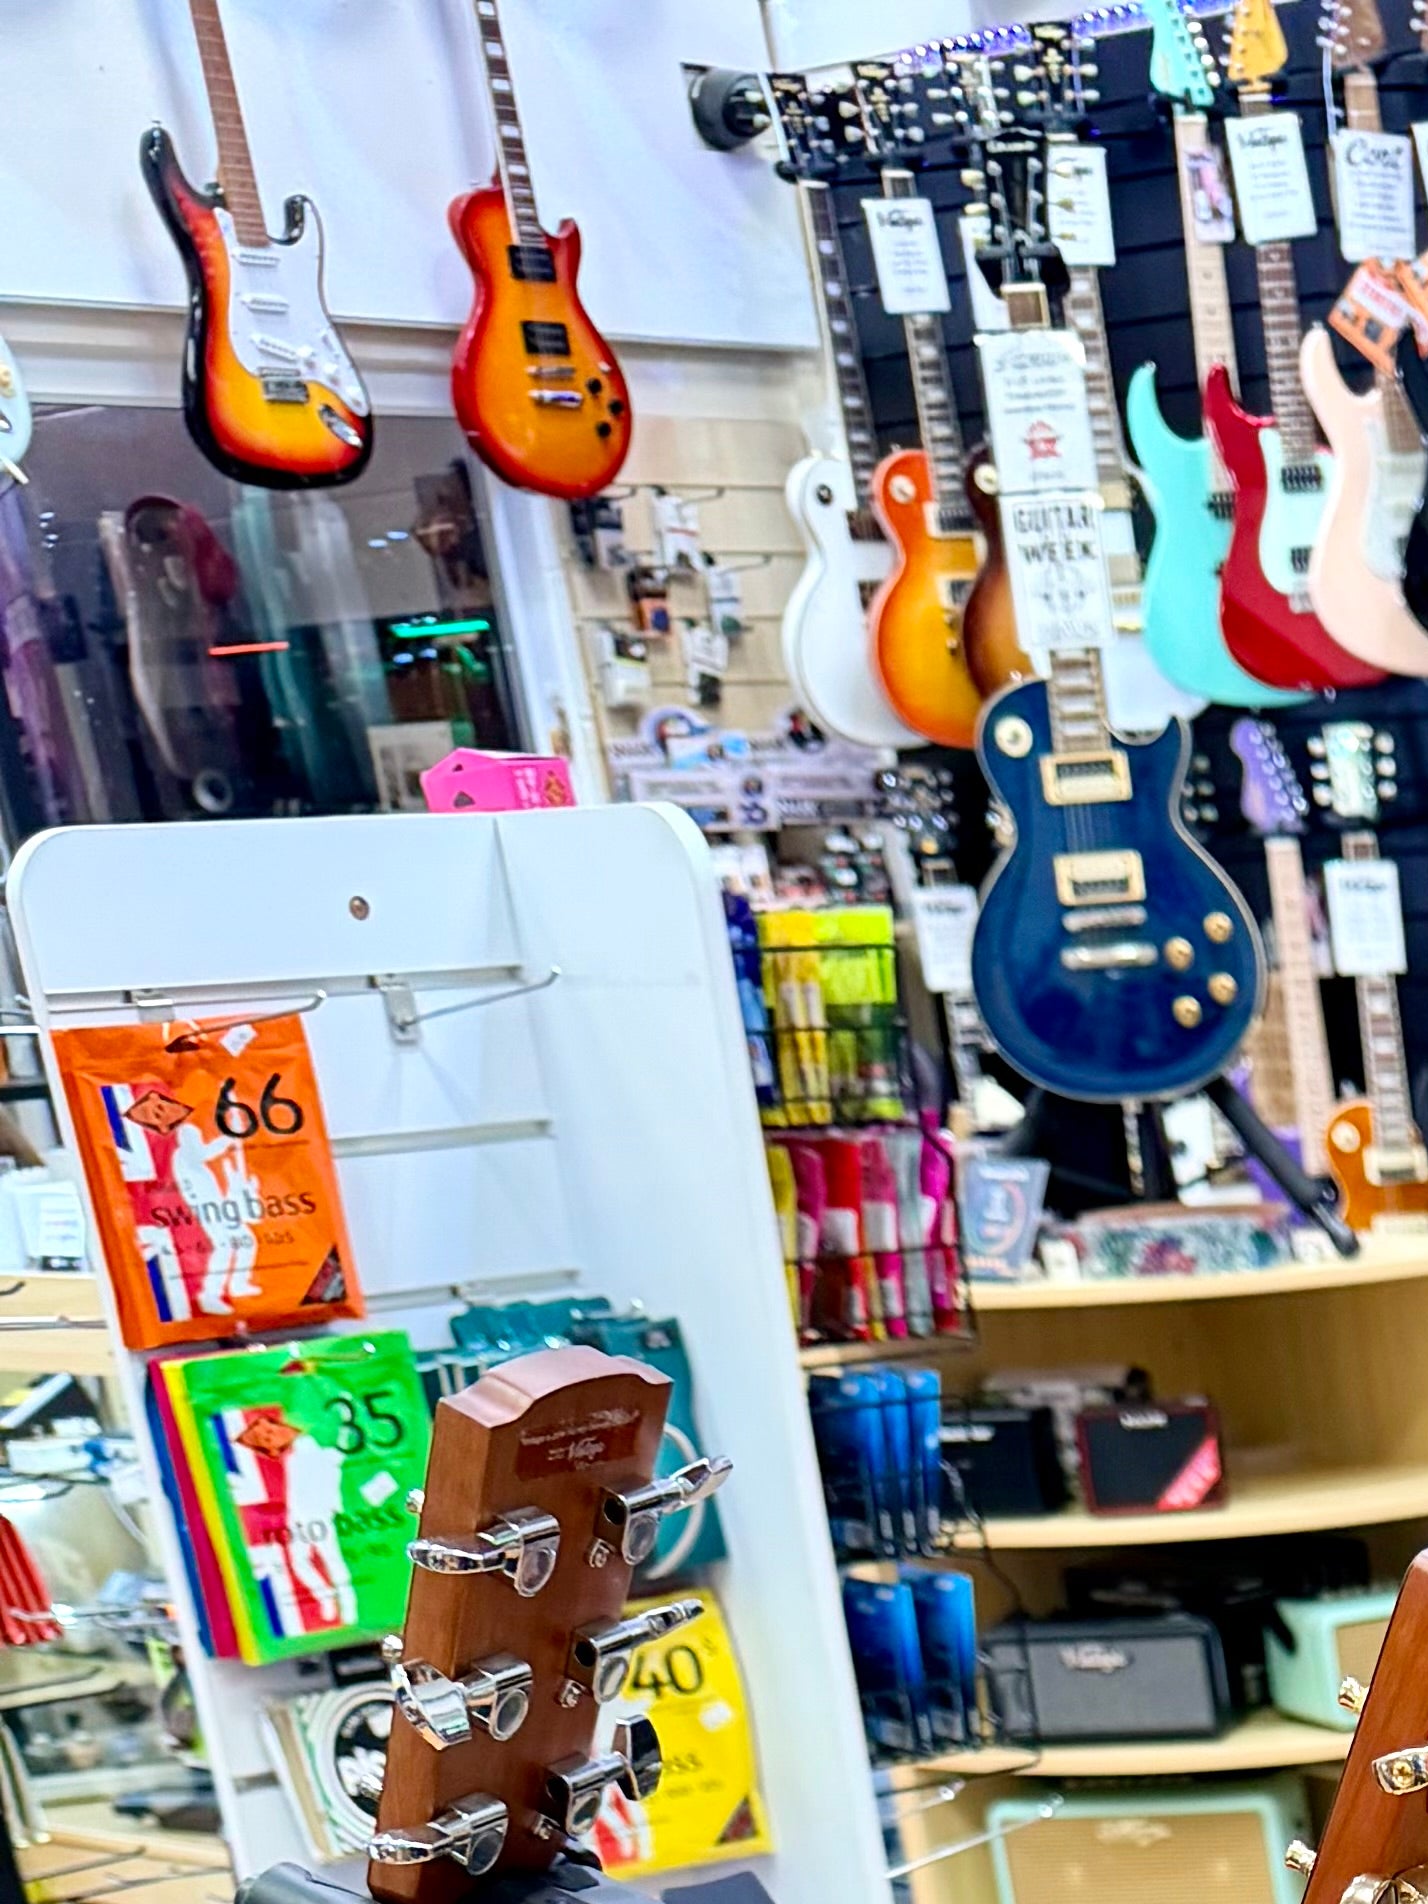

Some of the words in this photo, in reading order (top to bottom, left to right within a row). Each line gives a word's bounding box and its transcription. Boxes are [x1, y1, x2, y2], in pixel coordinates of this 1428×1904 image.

[1345, 138, 1403, 169] Cort
[1013, 501, 1095, 533] GUITAR
[1018, 539, 1099, 564] WEEK
[214, 1072, 305, 1139] 66
[151, 1197, 241, 1230] swing
[244, 1189, 317, 1219] bass
[323, 1390, 405, 1455] 35
[632, 1645, 705, 1698] 40
